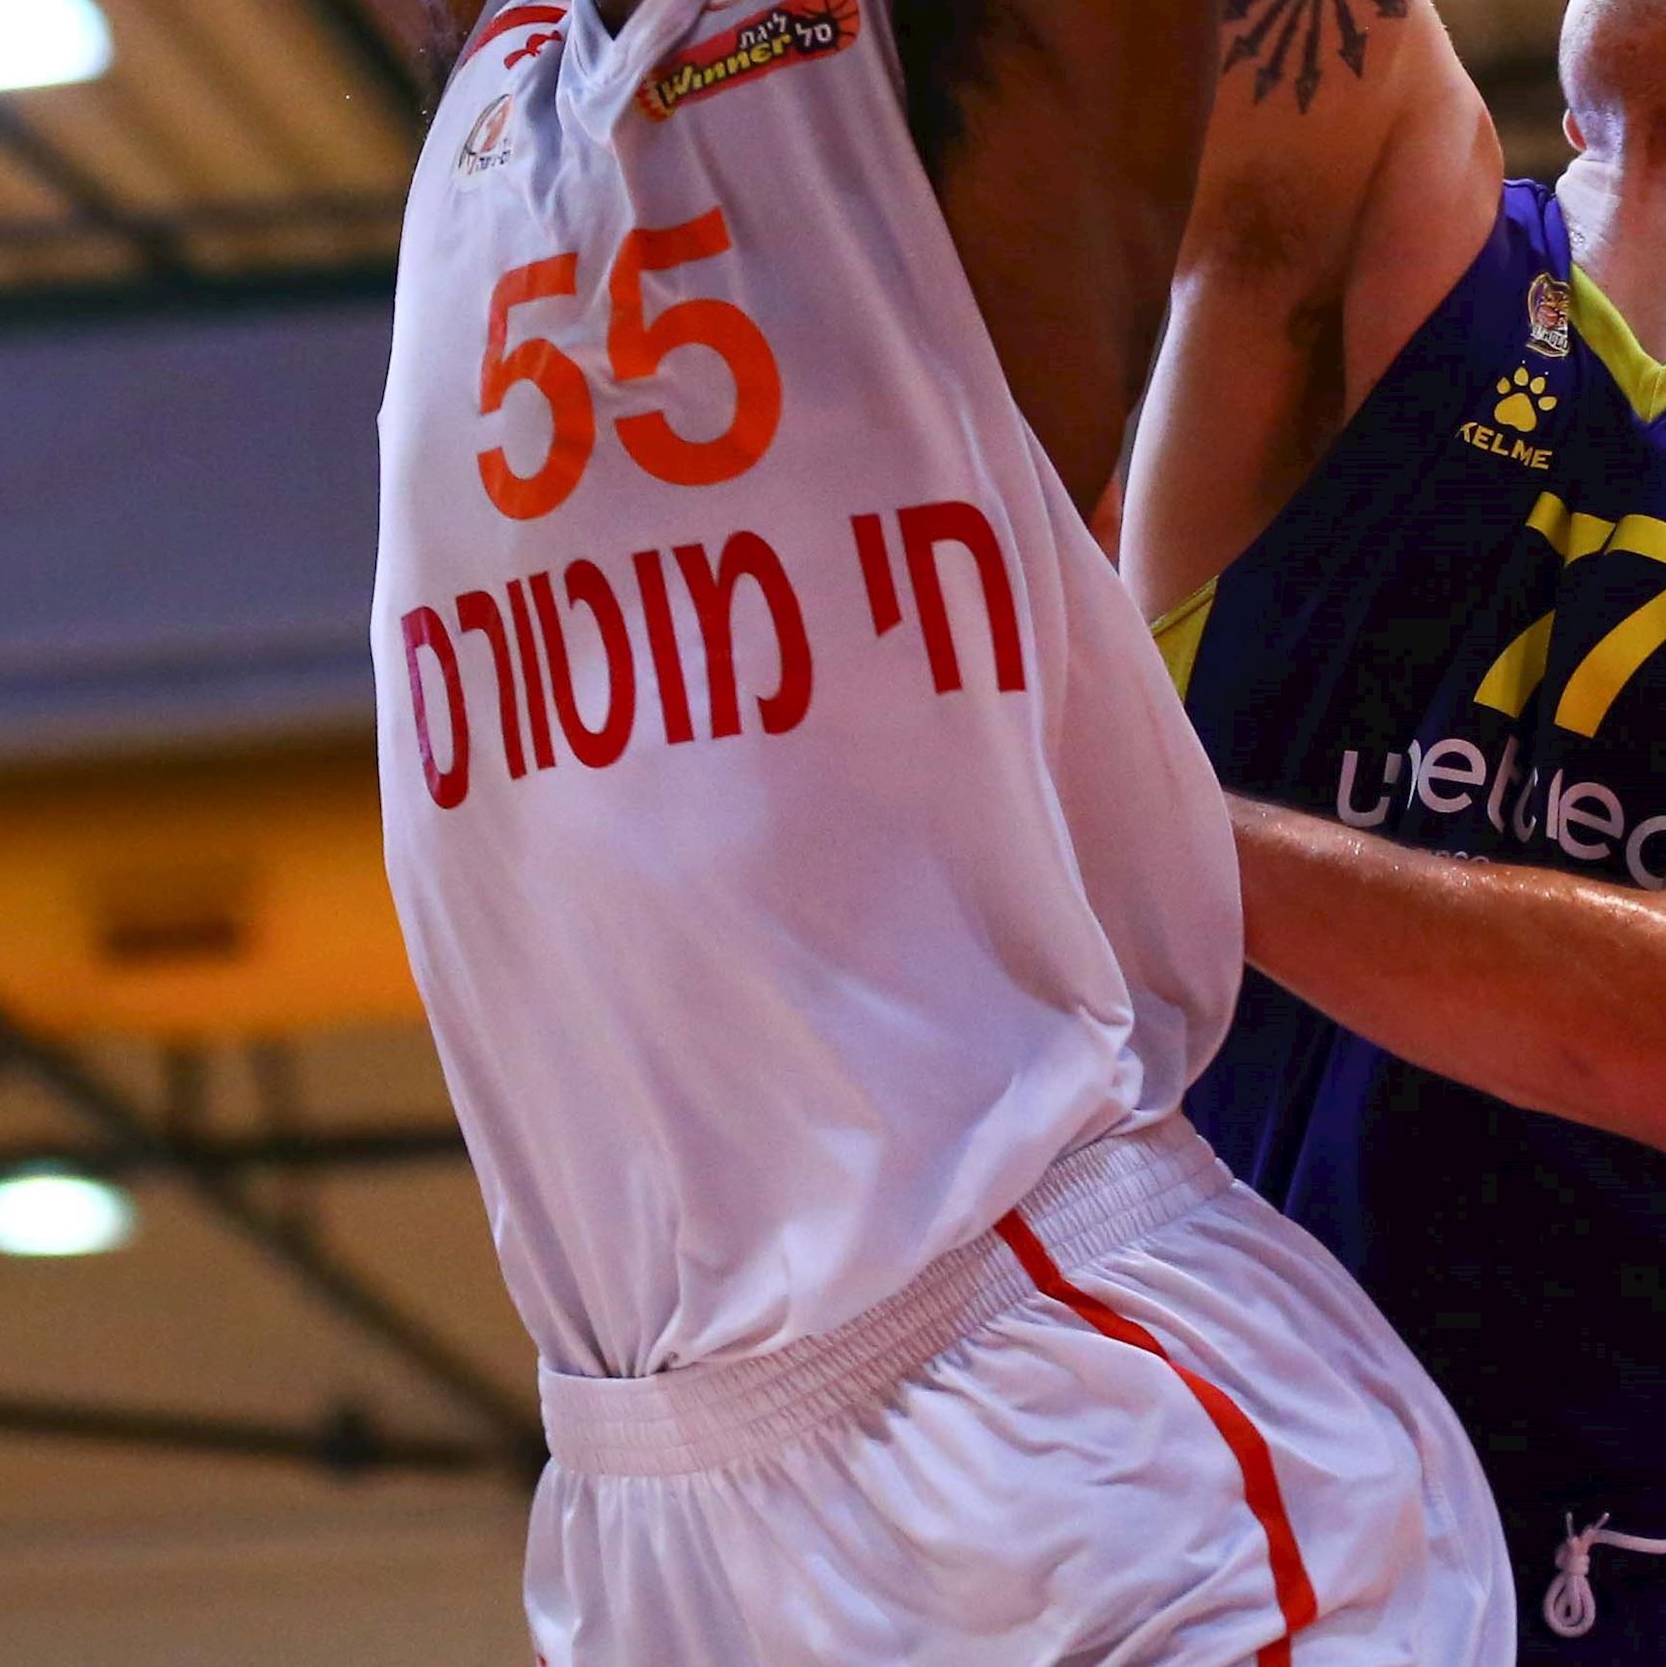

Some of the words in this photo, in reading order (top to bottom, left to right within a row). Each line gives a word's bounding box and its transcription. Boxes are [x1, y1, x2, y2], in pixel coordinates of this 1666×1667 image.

[657, 33, 793, 105] Winner
[477, 205, 782, 521] 55
[400, 529, 814, 810] מוטורס
[851, 500, 1027, 695] חי
